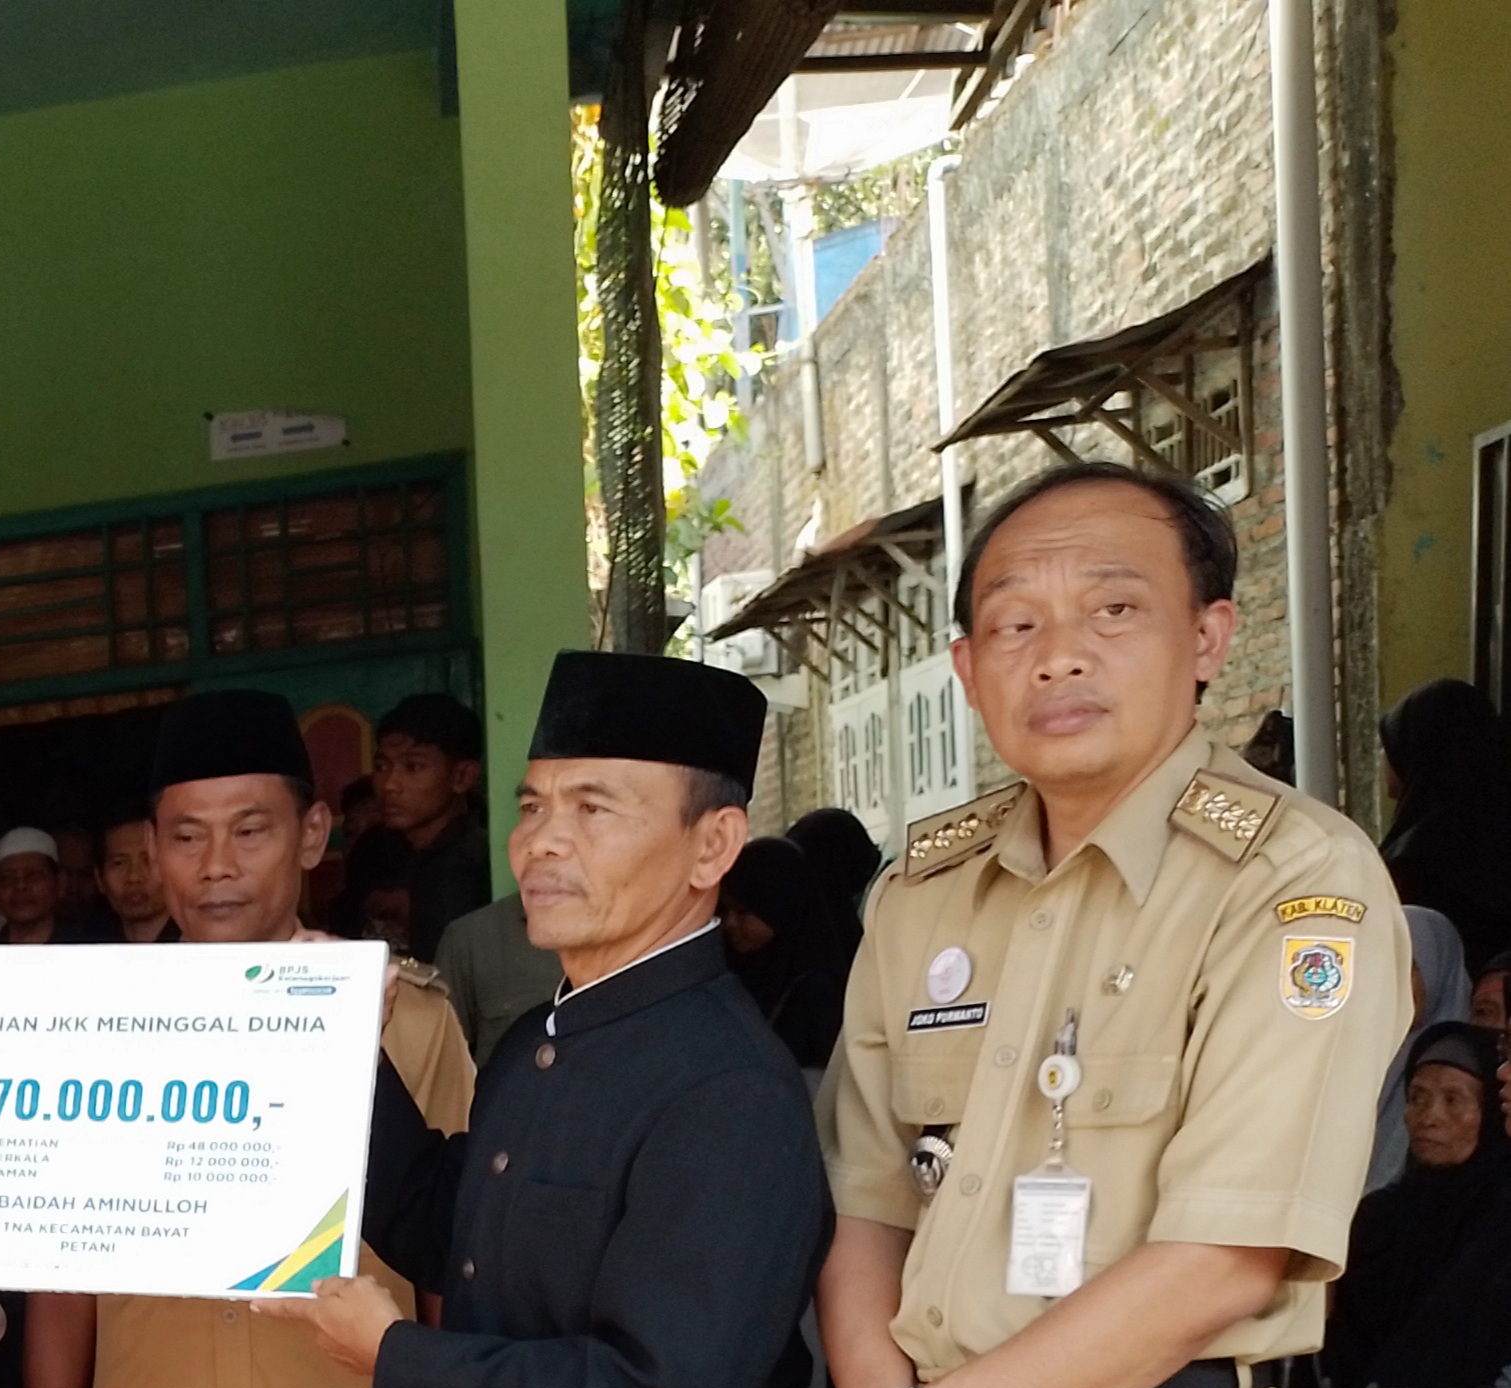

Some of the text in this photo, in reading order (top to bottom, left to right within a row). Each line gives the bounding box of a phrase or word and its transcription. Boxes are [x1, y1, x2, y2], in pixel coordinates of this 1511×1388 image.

[1314, 898, 1362, 918] KLATEN
[279, 965, 309, 975] BPJS
[45, 1016, 89, 1032] JKK
[96, 1016, 239, 1033] MENINGGAL
[248, 1016, 326, 1033] DUNIA
[167, 1141, 185, 1152] Rp
[165, 1156, 183, 1168] Rp
[163, 1171, 182, 1183] Rp
[82, 1197, 208, 1214] AMINULLOH
[38, 1223, 136, 1237] KECAMATAN
[140, 1225, 190, 1238] BAYAT
[60, 1240, 116, 1253] PETANI
